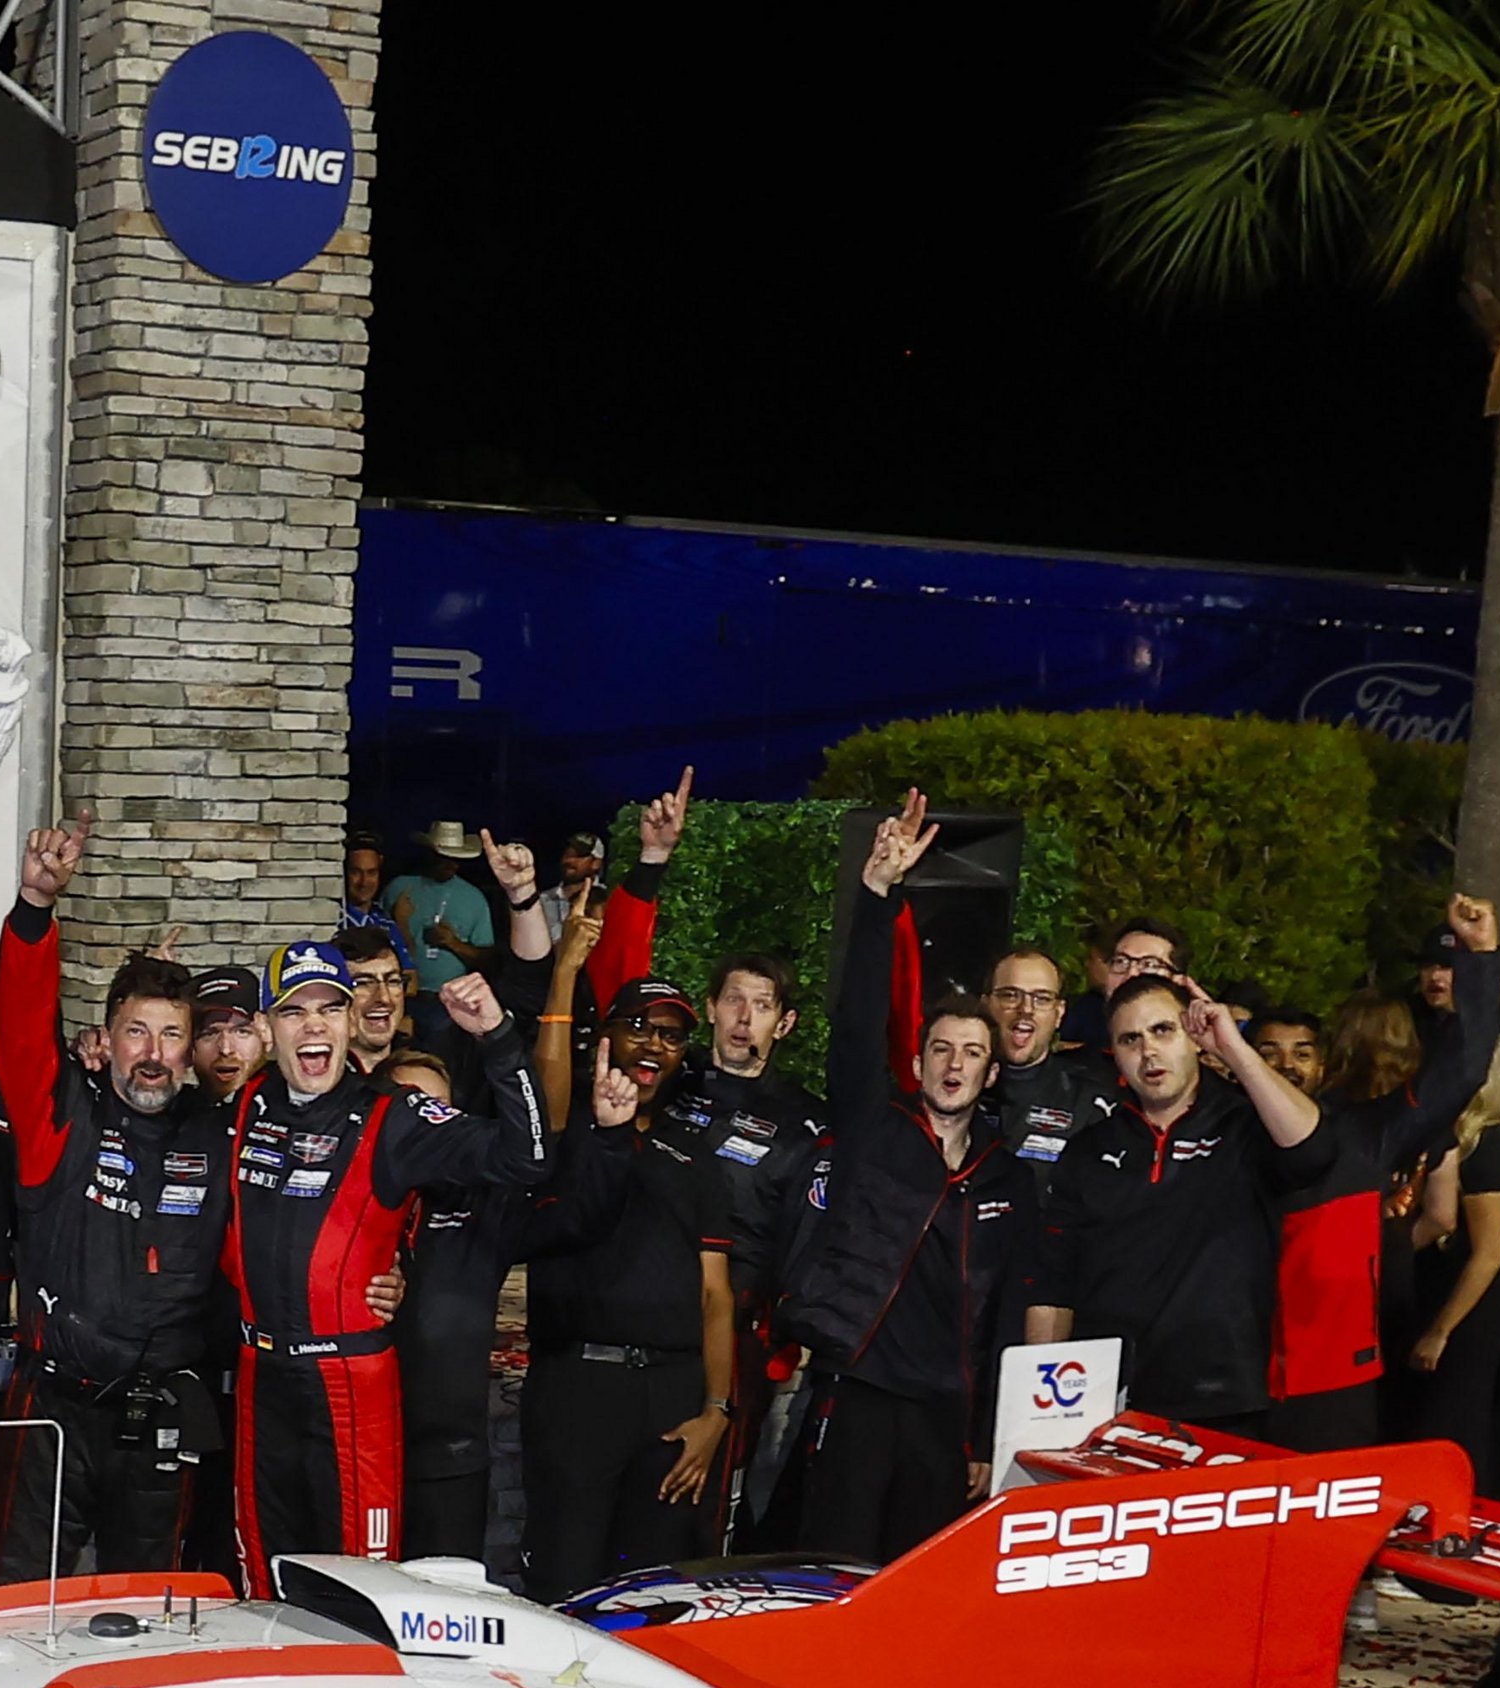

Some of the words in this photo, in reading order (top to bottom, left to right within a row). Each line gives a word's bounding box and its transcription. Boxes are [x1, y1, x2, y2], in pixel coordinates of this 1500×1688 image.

[999, 1475, 1383, 1552] PORSCHE
[995, 1542, 1150, 1596] 963
[400, 1610, 478, 1645] Mobil
